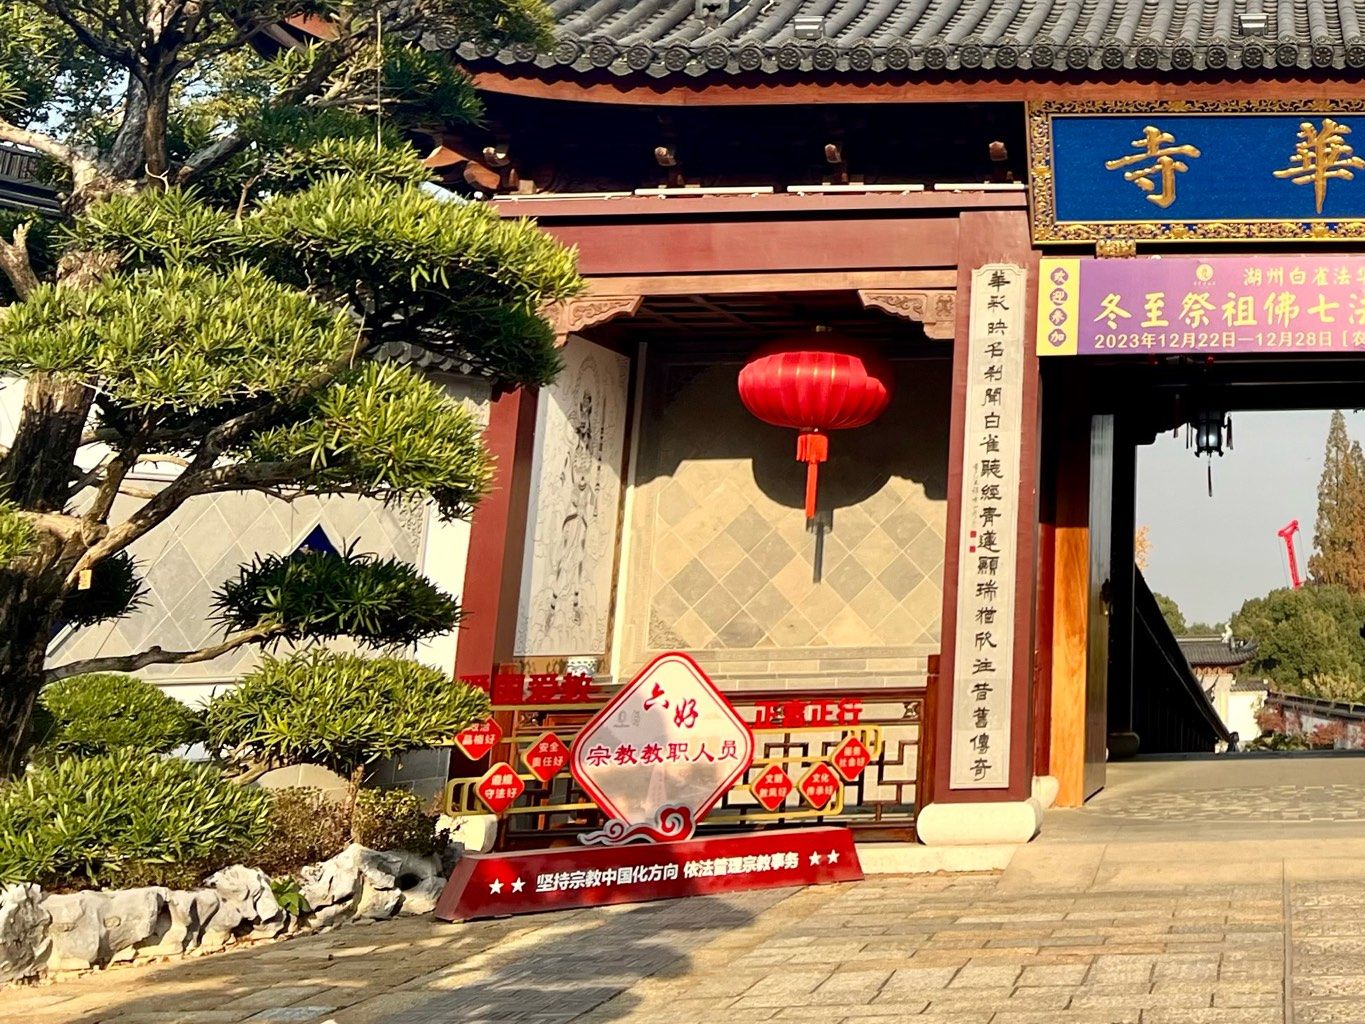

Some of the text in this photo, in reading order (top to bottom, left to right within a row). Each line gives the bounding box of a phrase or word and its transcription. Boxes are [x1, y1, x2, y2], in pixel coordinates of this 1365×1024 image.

[1049, 268, 1069, 345] 欢迎参加
[644, 682, 699, 728] 六好
[532, 756, 564, 768] 责任好
[539, 742, 560, 753] 安全
[586, 740, 739, 766] 宗教教职人员
[536, 851, 799, 892] 坚持宗教中国化方向 依法管理宗教事务
